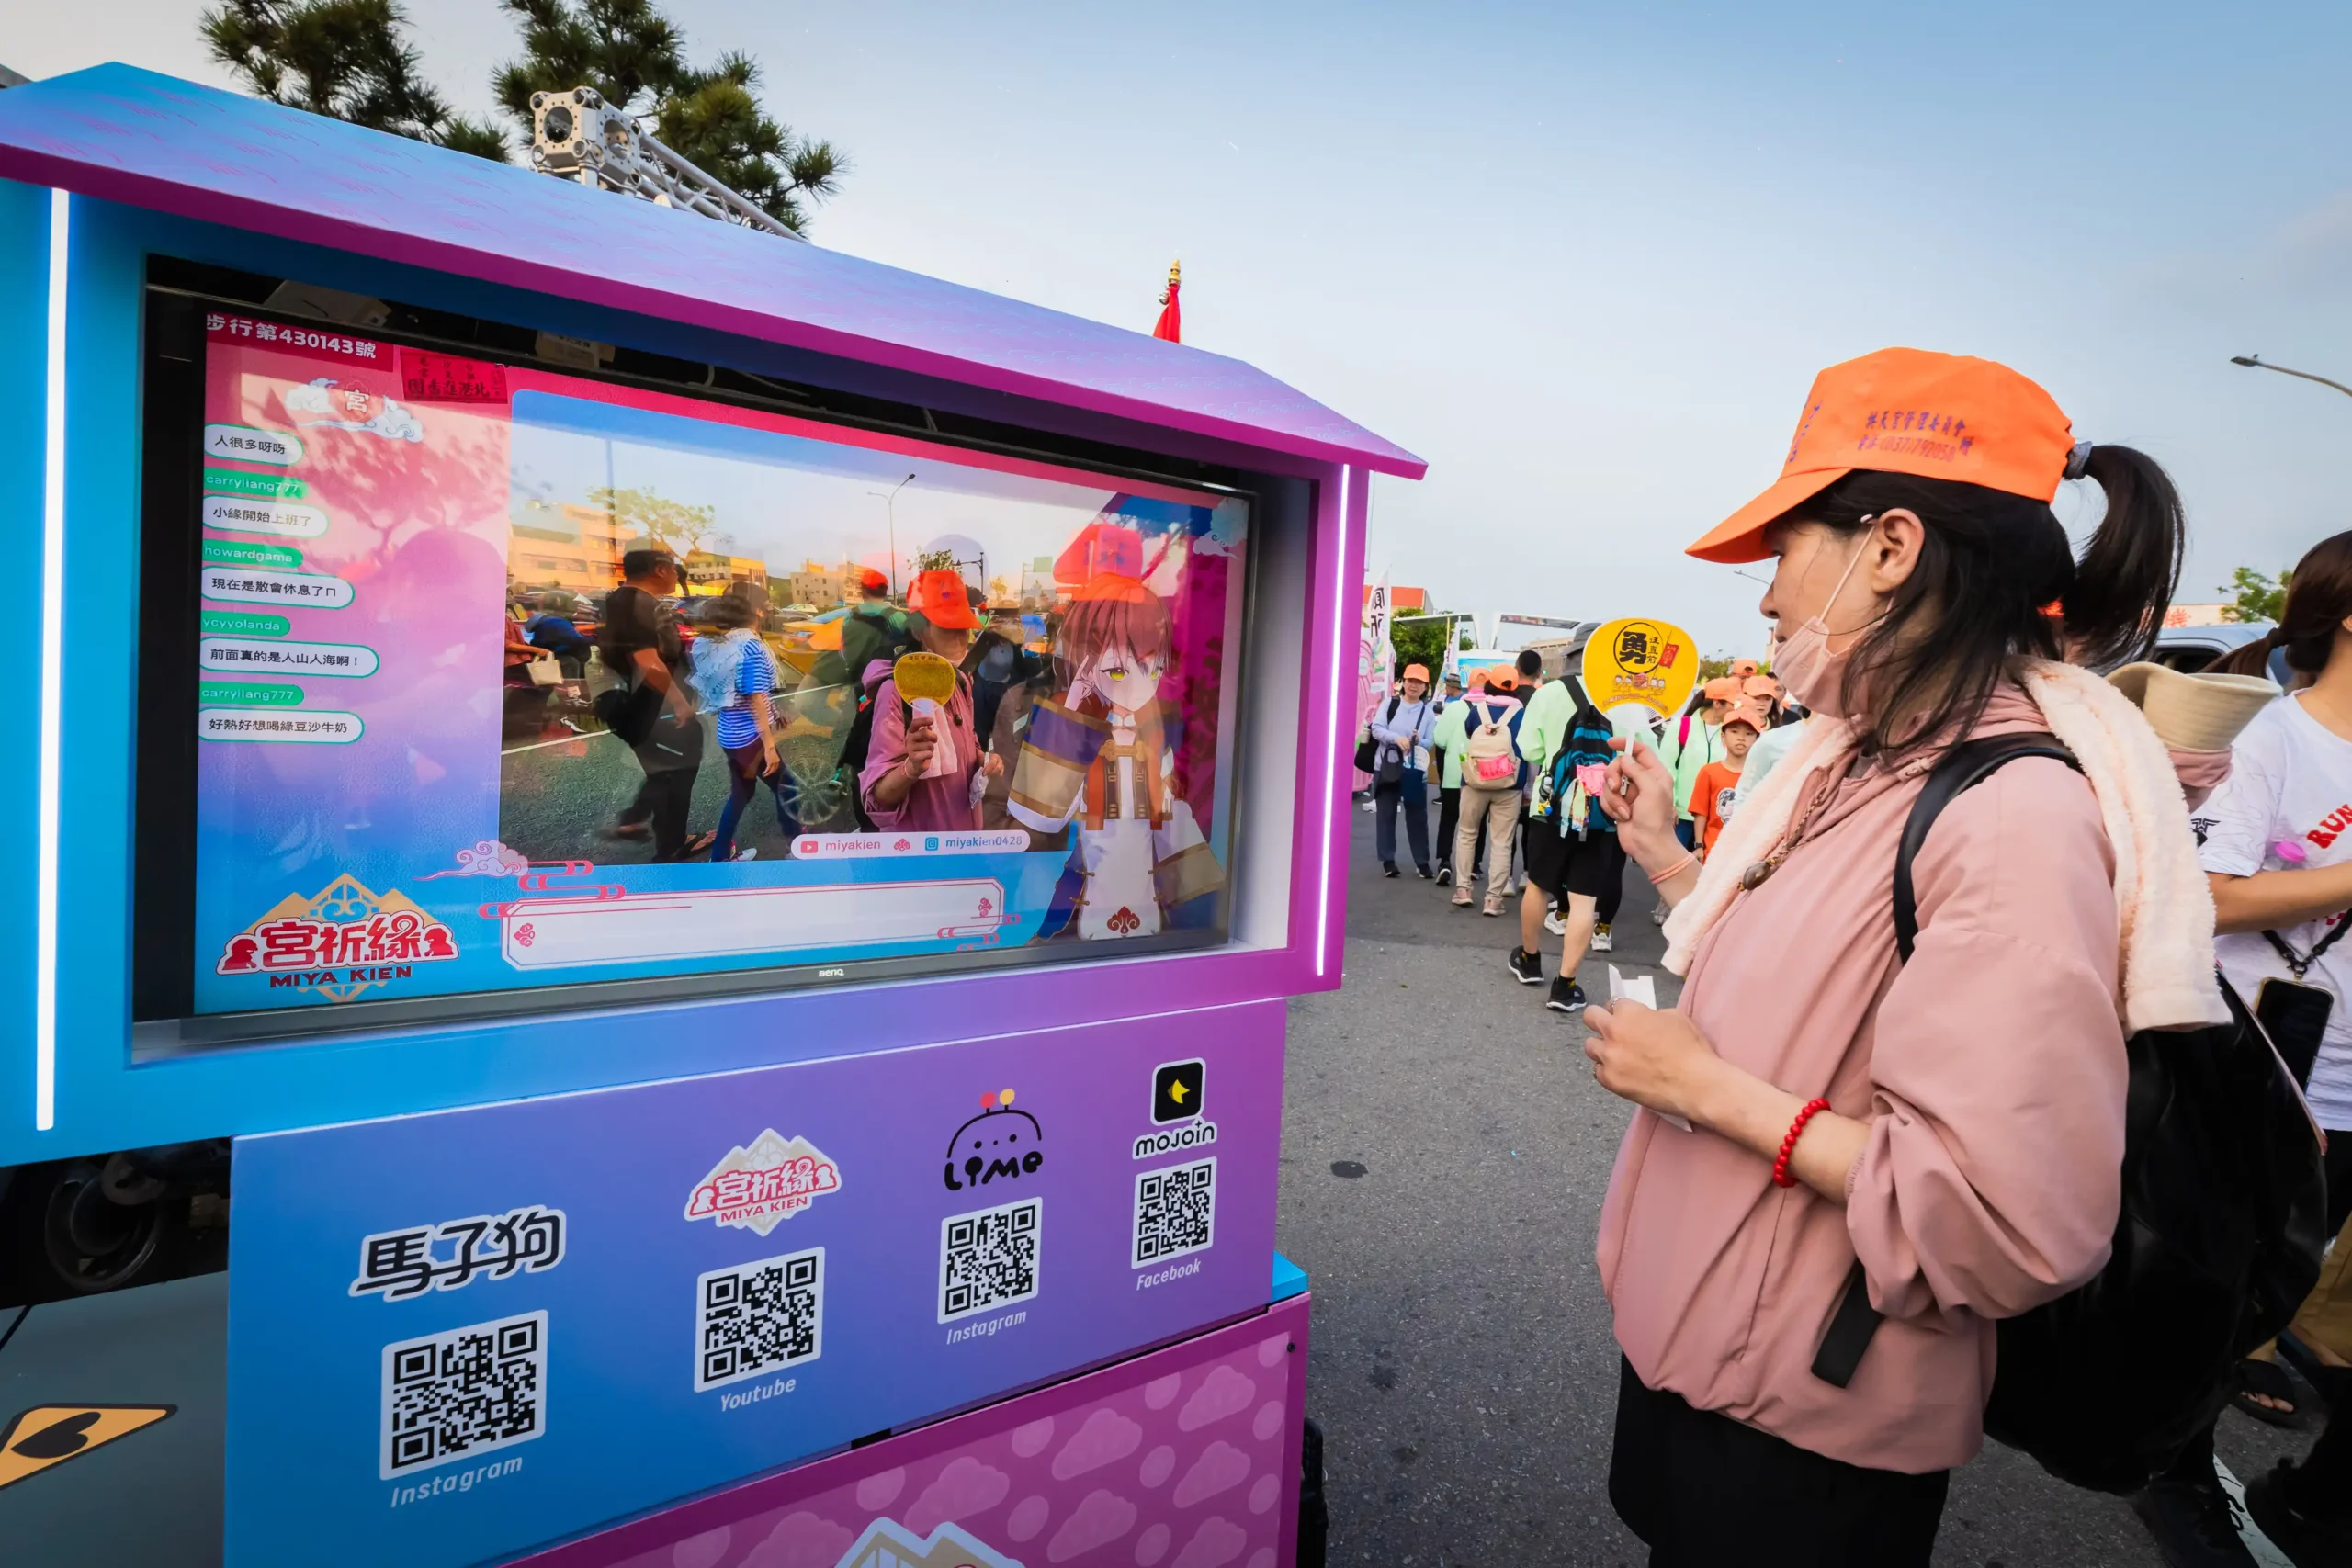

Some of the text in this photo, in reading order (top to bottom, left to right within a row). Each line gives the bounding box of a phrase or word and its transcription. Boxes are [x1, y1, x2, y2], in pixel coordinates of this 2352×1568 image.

[206, 313, 376, 359] 步行第430143號
[345, 389, 369, 412] 宮
[215, 434, 287, 455] 人很多呀呀
[206, 477, 299, 493] carryliang777
[213, 507, 311, 527] 小緣開始上班了
[202, 618, 280, 632] ycyyolanda
[1619, 631, 1647, 665] 勇
[201, 688, 294, 701] carryliang777
[209, 718, 347, 733] 好熱好想喝綠豆沙牛奶
[825, 840, 881, 852] miyakien
[945, 836, 1023, 849] miyakien0428
[261, 911, 421, 967] 宮祈緣
[270, 965, 412, 988] MIYA KIEN
[1136, 1120, 1215, 1156] mojoin
[716, 1158, 813, 1209] 宮祈緣
[720, 1196, 808, 1222] MIYA KIEN
[1136, 1258, 1201, 1291] Facebook
[946, 1311, 1027, 1345] Instagram
[720, 1378, 797, 1412] Youtube
[390, 1457, 523, 1508] Instagram
